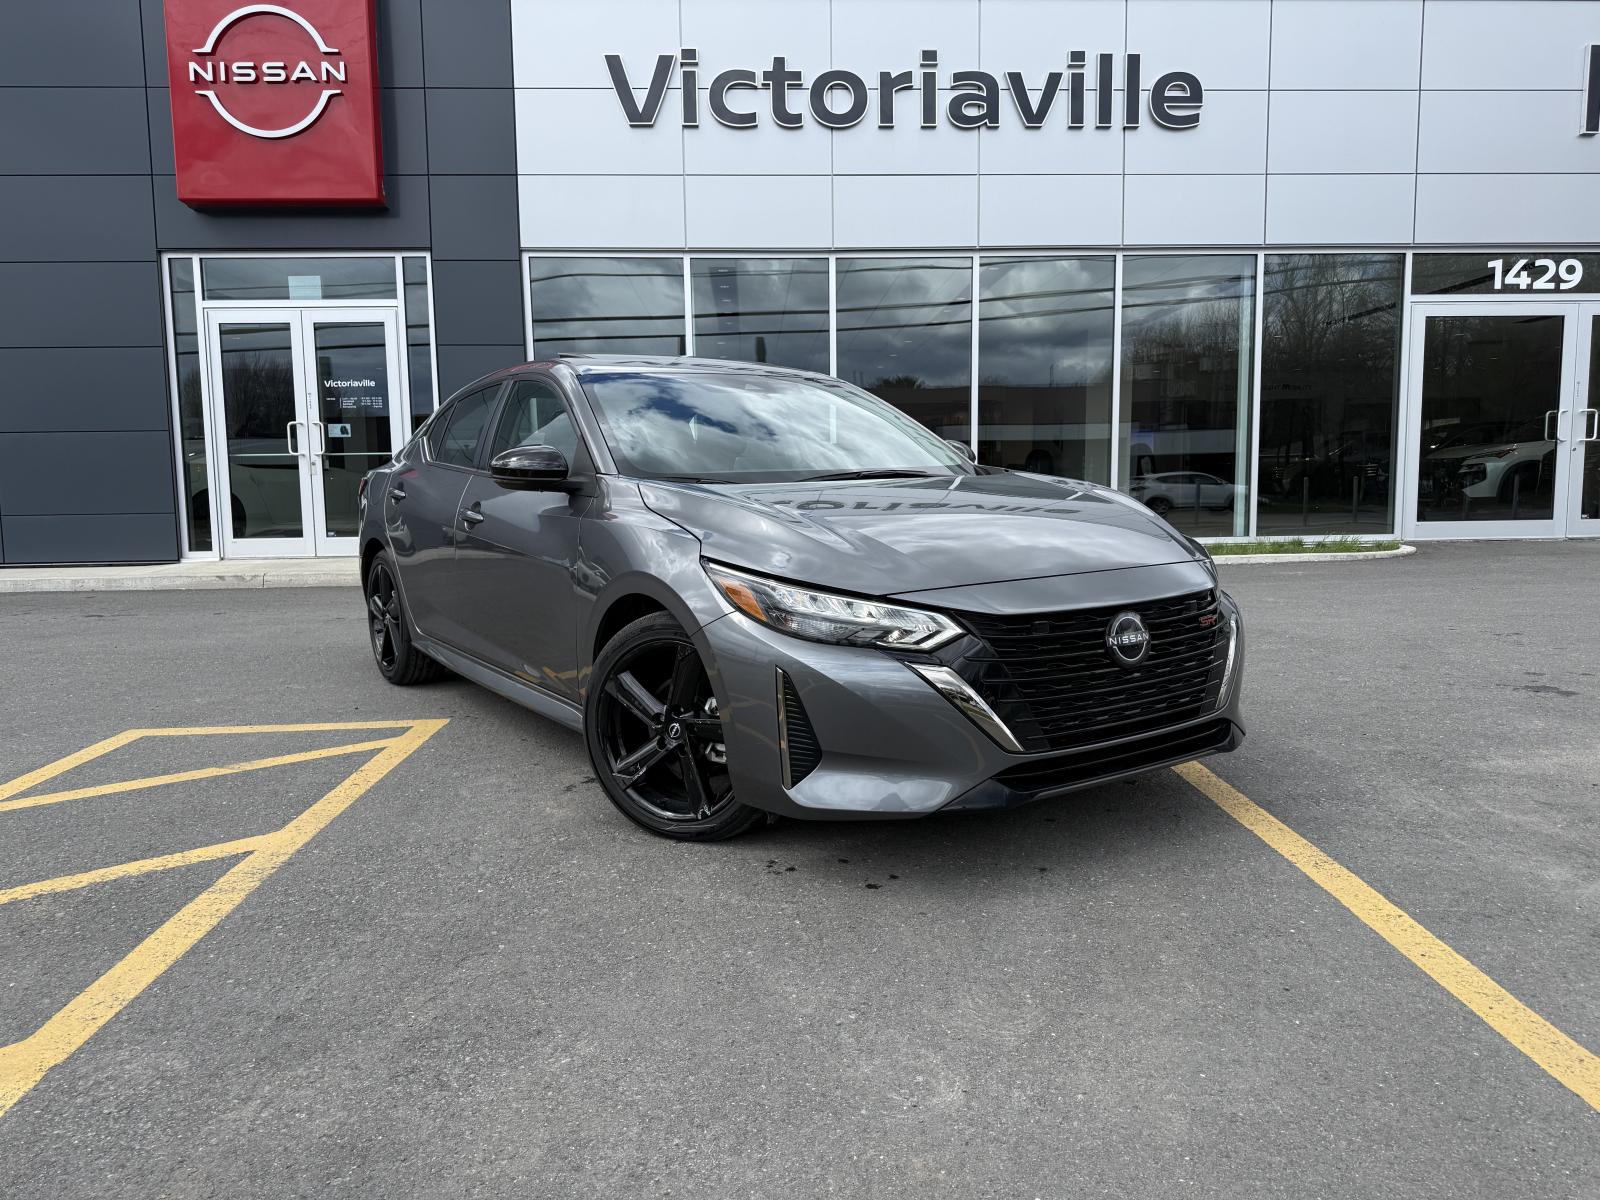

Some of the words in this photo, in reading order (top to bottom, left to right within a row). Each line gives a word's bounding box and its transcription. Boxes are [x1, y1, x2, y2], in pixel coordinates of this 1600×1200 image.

[189, 61, 347, 83] NISSAN
[603, 49, 1204, 129] Victoriaville
[1487, 258, 1583, 290] 1429
[324, 379, 376, 388] Victoriaville
[1108, 632, 1149, 645] NISSAN
